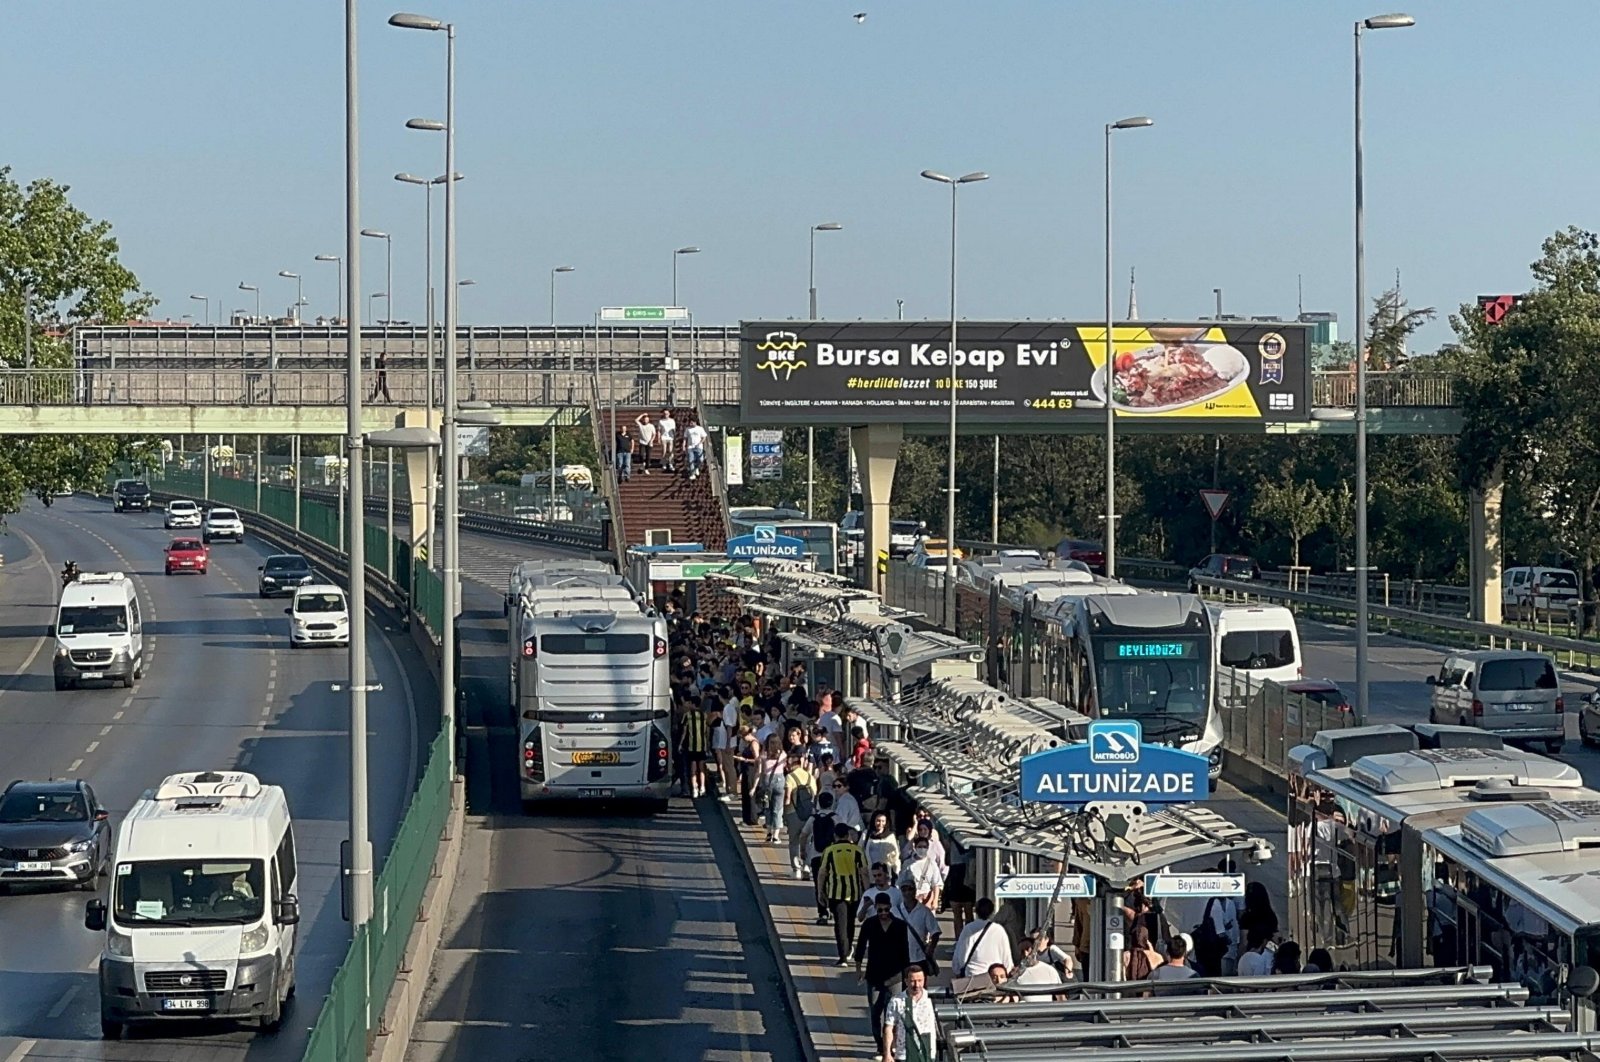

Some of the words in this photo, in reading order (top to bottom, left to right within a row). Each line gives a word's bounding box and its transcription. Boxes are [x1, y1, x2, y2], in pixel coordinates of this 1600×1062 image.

[768, 350, 795, 361] BKE
[817, 343, 899, 366] Bursa
[911, 342, 1005, 373] Kebap
[1017, 342, 1057, 366] Evi
[847, 377, 930, 389] #herdildelezzet
[935, 379, 944, 389] 10
[945, 377, 964, 389] ÜKE
[965, 379, 977, 389] 150
[979, 379, 998, 391] ŞUBE
[1032, 399, 1056, 408] 444
[1058, 399, 1073, 408] 63
[733, 544, 798, 555] ALTUNİZADE
[1119, 644, 1182, 656] BEYLİKDÜZÜ
[1095, 751, 1136, 760] METROBÜS
[1036, 768, 1194, 793] ALTUNİZADE
[167, 1000, 176, 1008] 34
[180, 1000, 193, 1008] LTA
